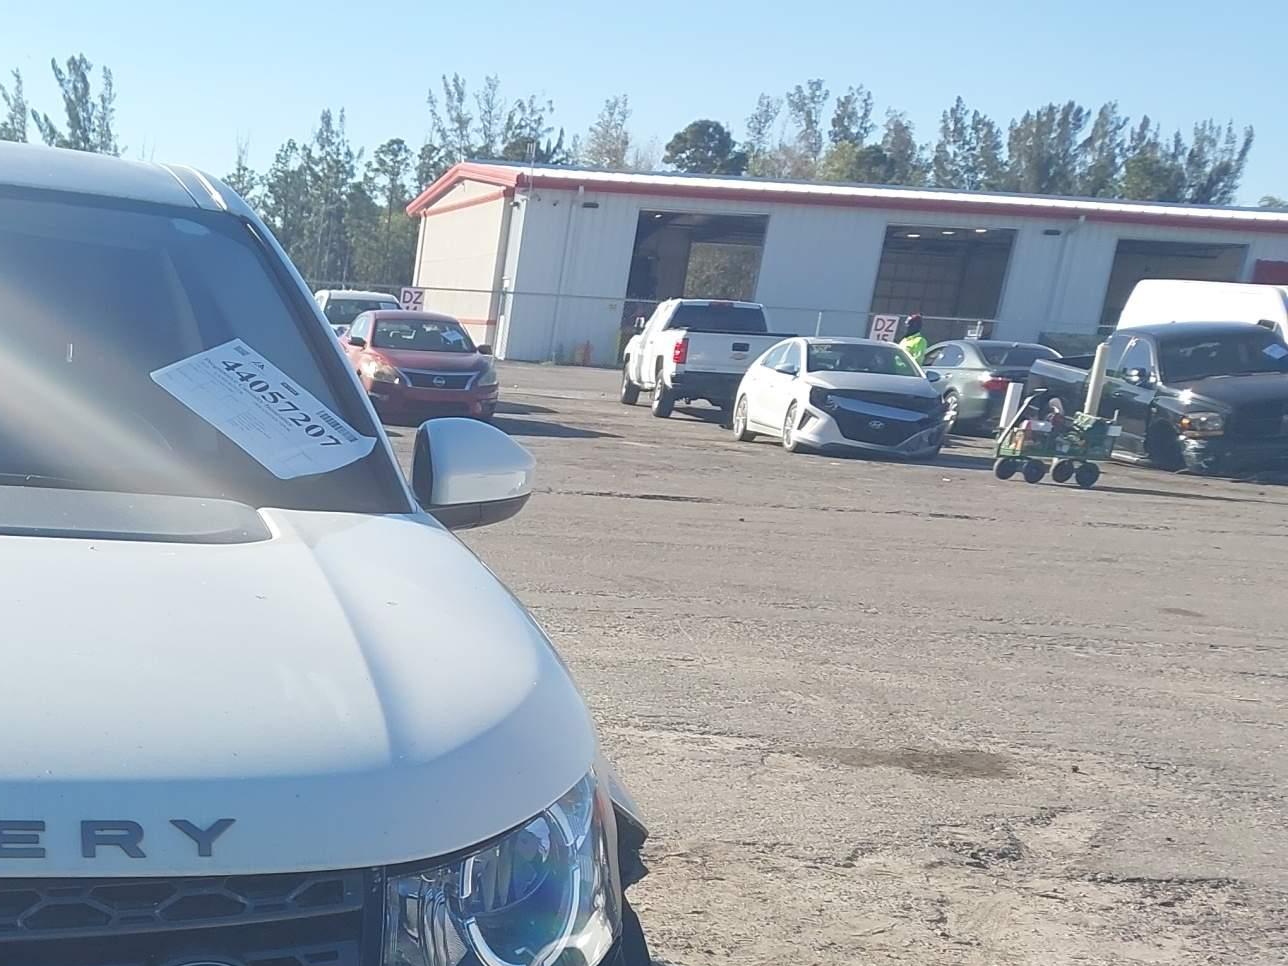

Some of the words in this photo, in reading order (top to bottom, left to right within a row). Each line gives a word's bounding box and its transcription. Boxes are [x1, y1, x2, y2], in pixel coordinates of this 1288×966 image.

[402, 290, 423, 304] DZ
[874, 317, 897, 332] DZ
[221, 359, 343, 447] 44057207
